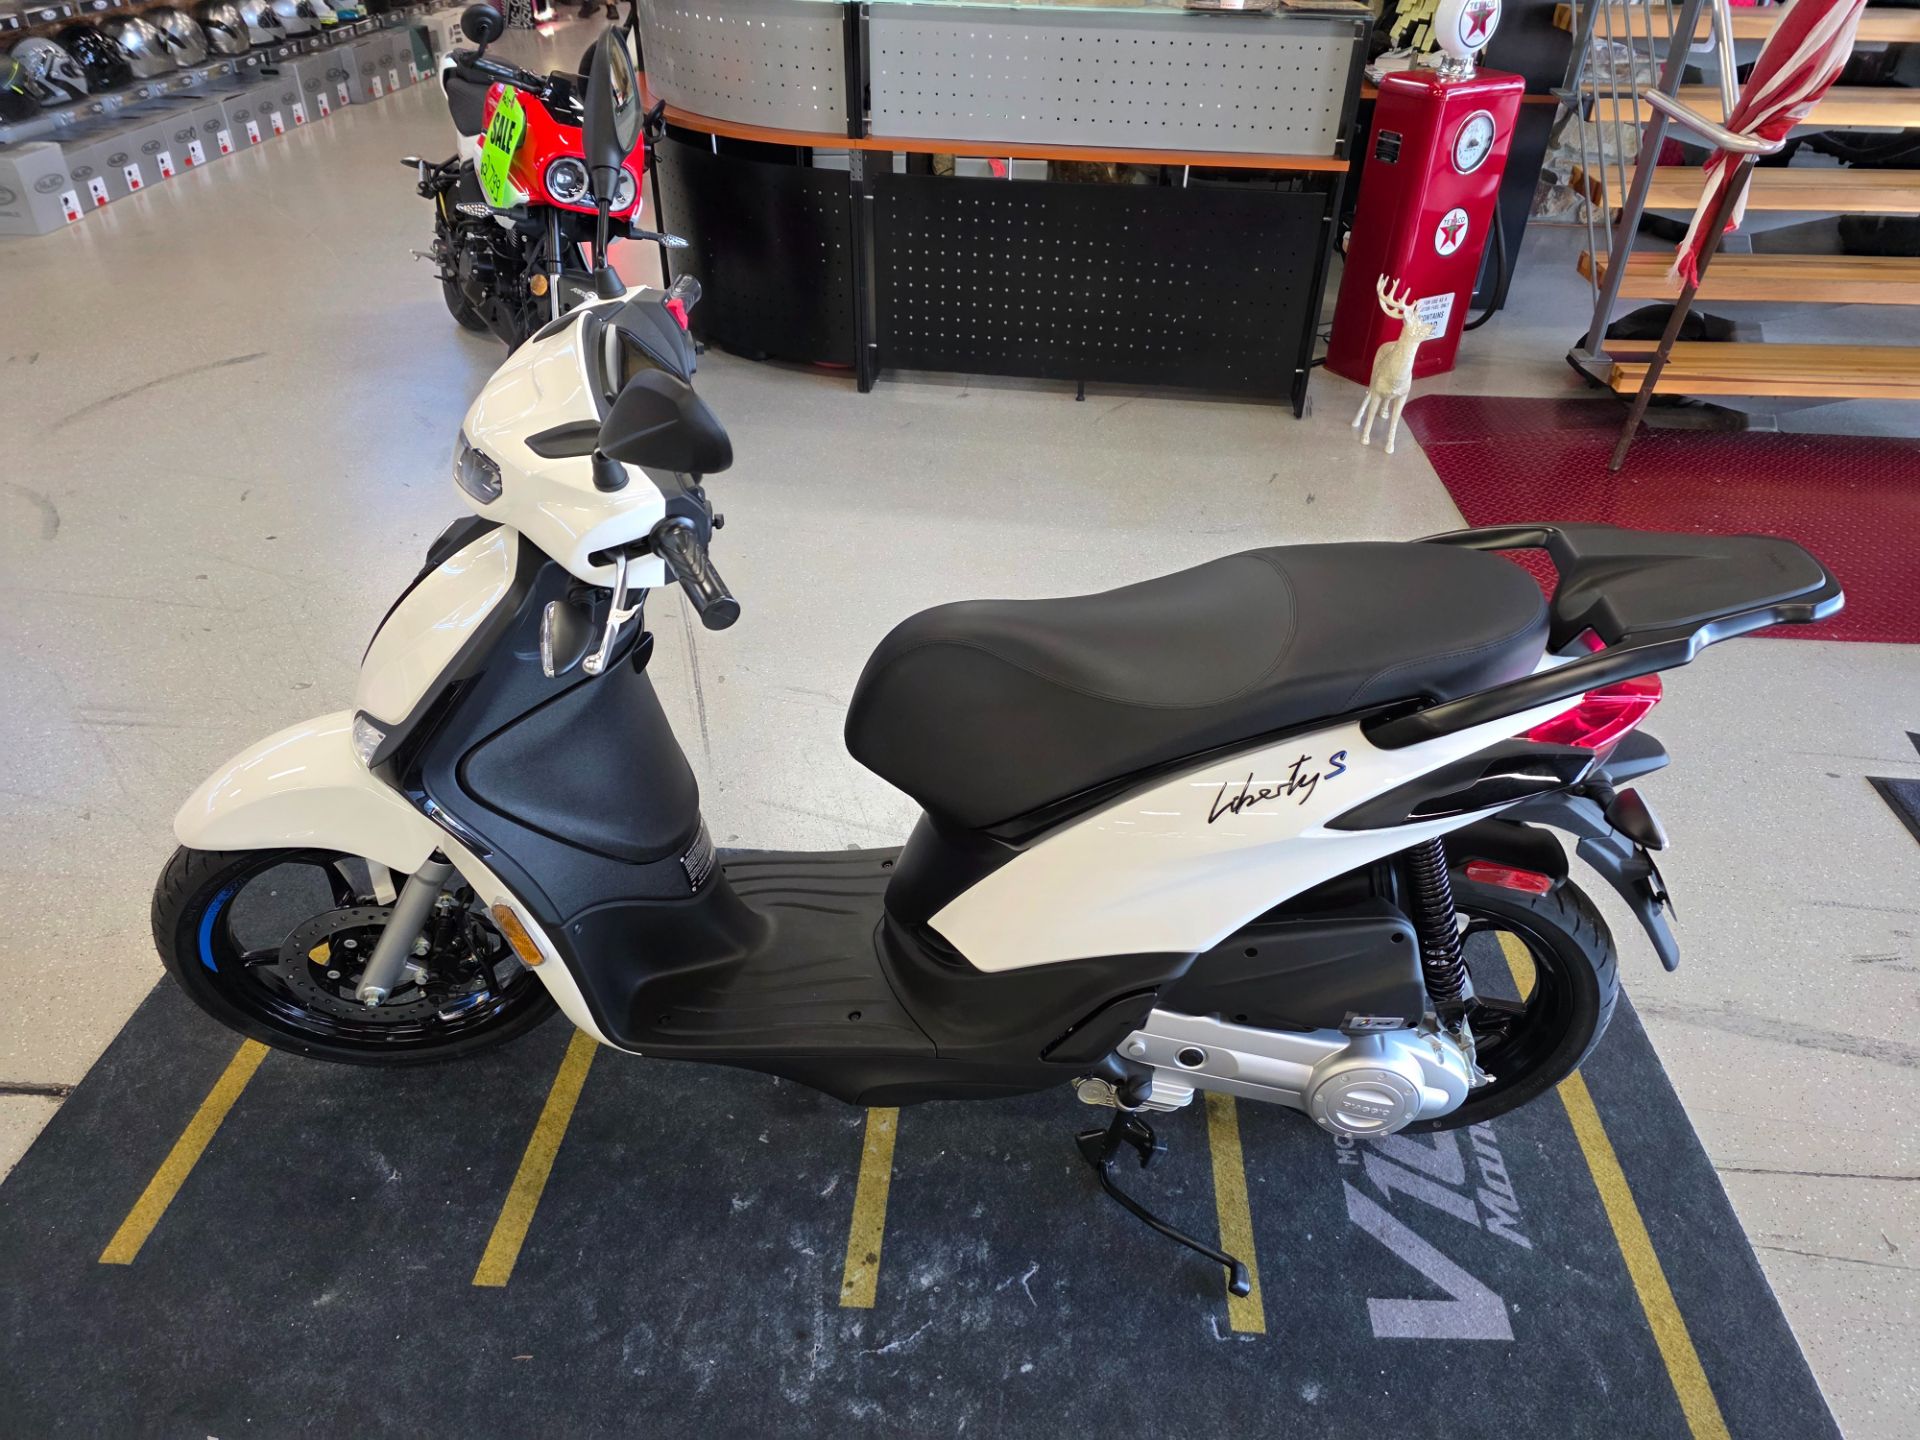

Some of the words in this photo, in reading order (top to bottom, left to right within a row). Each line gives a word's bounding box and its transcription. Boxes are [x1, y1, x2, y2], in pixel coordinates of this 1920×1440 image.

[490, 111, 516, 155] SALE
[1207, 754, 1320, 824] Liberty
[1323, 750, 1348, 780] S
